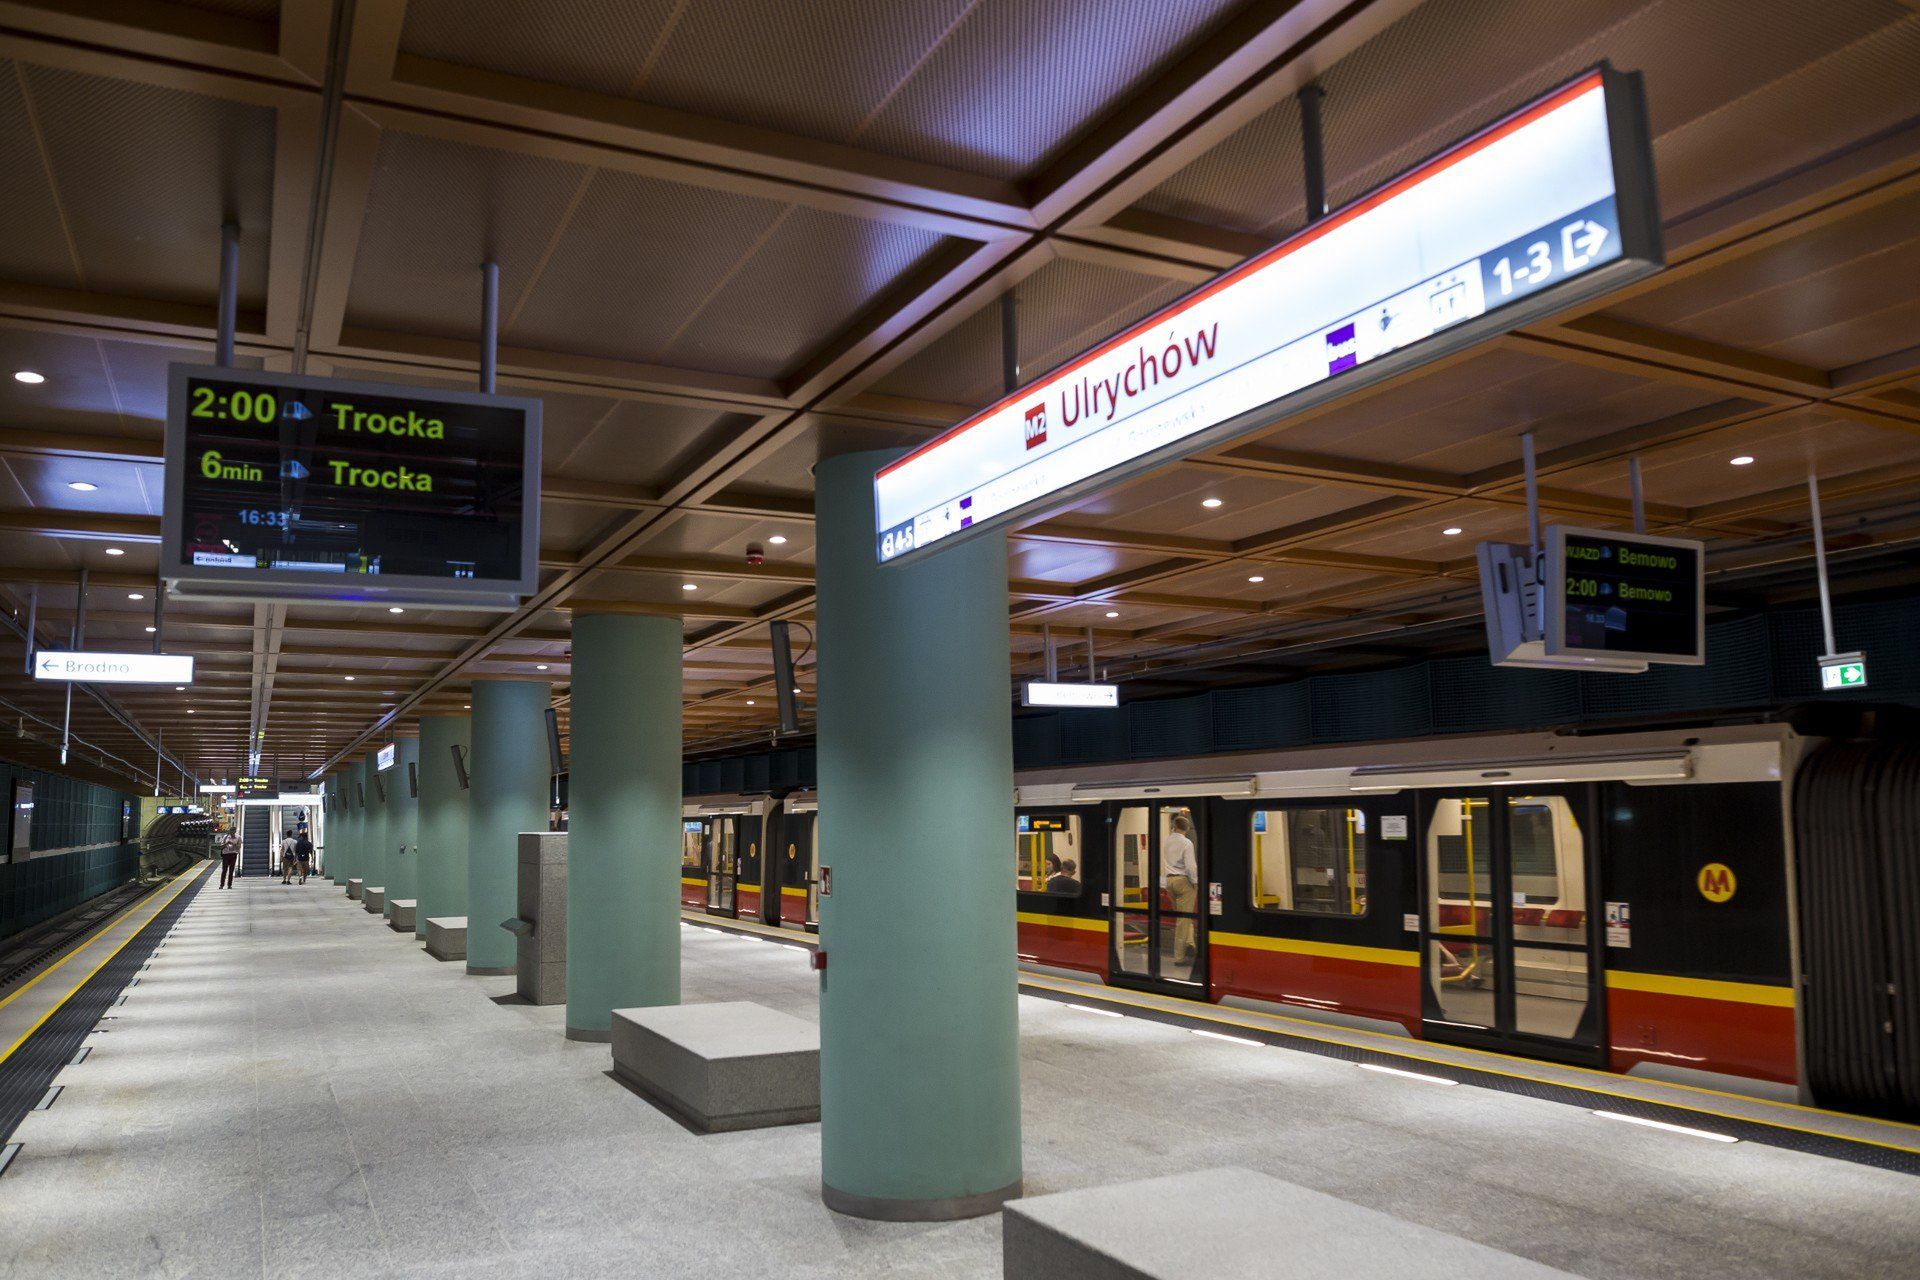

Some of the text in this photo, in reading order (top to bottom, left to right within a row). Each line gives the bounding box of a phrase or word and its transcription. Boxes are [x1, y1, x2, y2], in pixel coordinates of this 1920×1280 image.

[1493, 242, 1552, 295] 1-3
[1025, 411, 1047, 439] M2
[1061, 322, 1219, 428] Ulrychów
[192, 386, 444, 439] 2:00 Trocka
[328, 460, 433, 492] Trocka
[1619, 548, 1676, 569] Bemowo
[1567, 578, 1672, 602] 2:00 Bemowo
